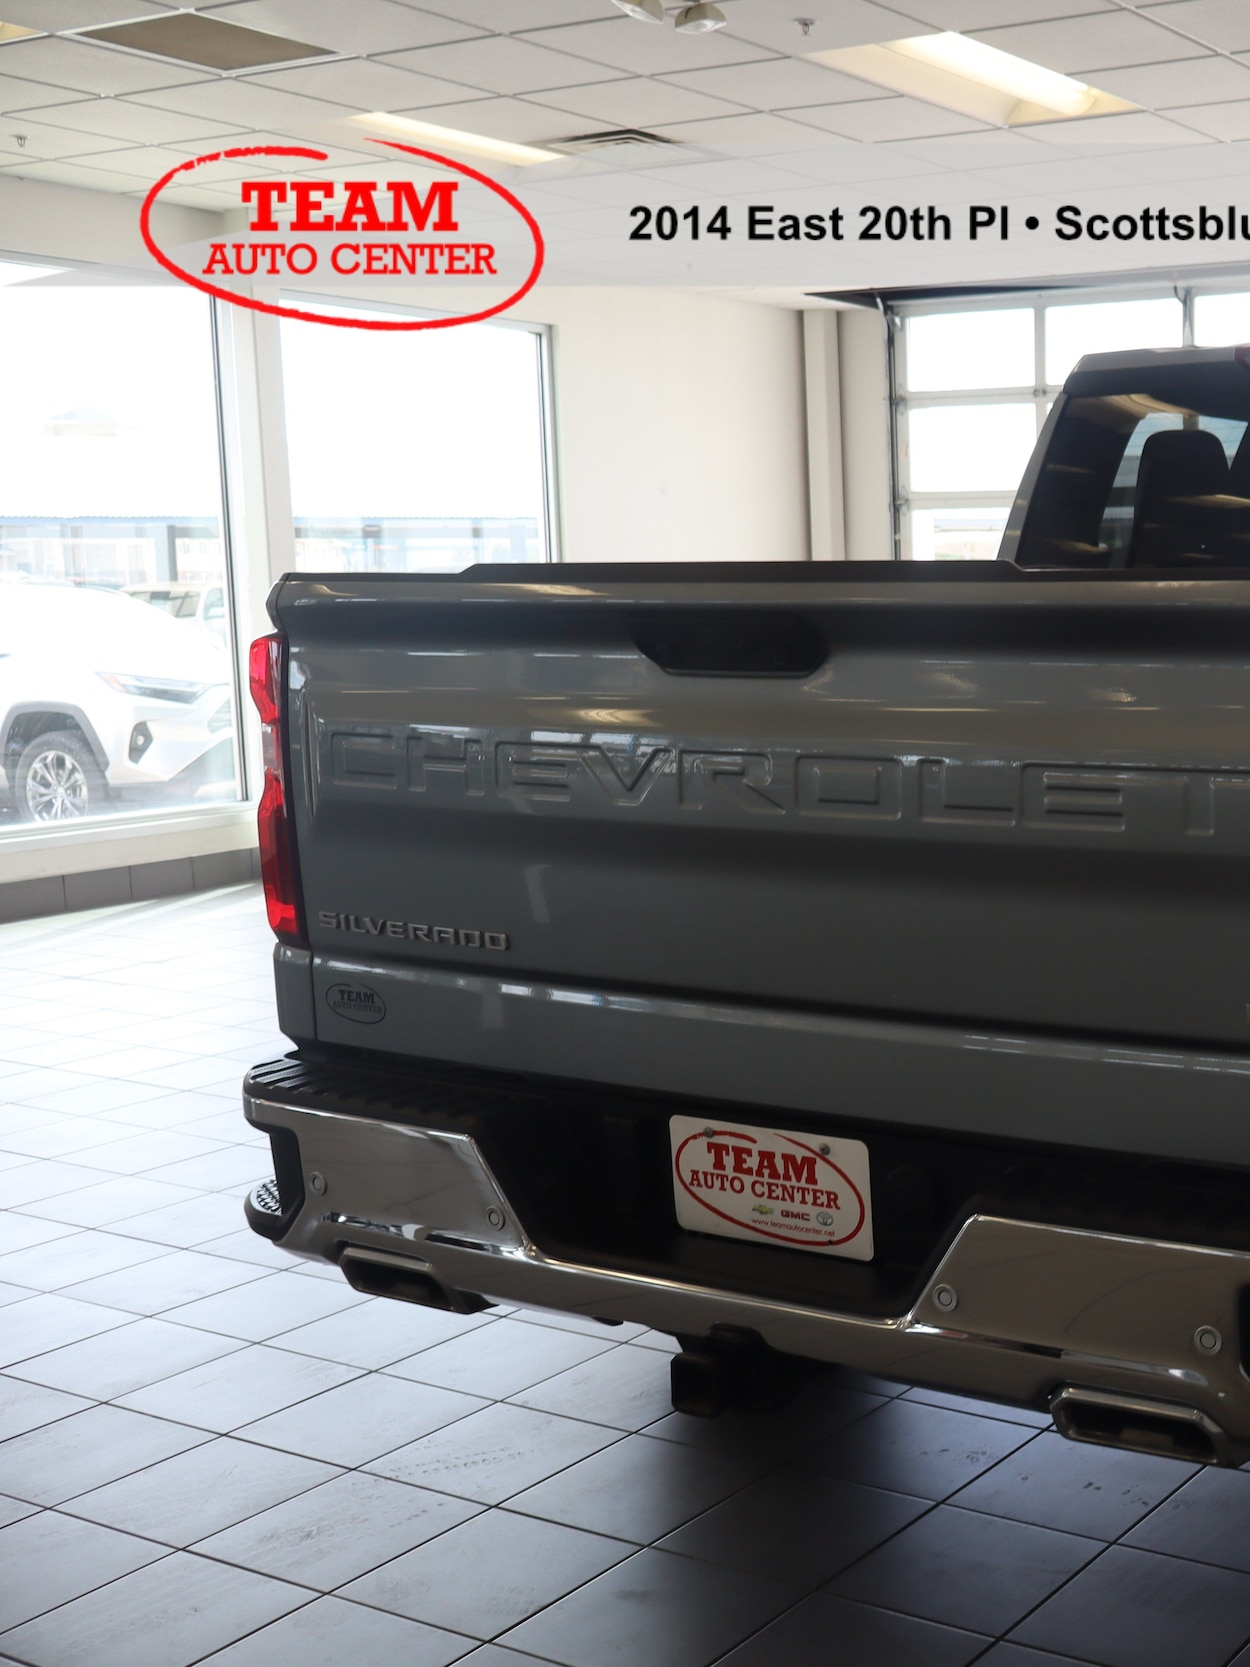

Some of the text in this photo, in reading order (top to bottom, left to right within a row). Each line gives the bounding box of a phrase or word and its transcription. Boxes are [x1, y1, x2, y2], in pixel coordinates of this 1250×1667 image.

[318, 910, 510, 951] SILVERADO
[332, 1000, 384, 1014] AUTO CENTER
[338, 989, 376, 1005] TEAM
[707, 1141, 818, 1186] TEAM
[689, 1169, 841, 1210] AUTO CENTER
[780, 1209, 811, 1222] GMC
[751, 1217, 836, 1238] www.teamautocenter.net
